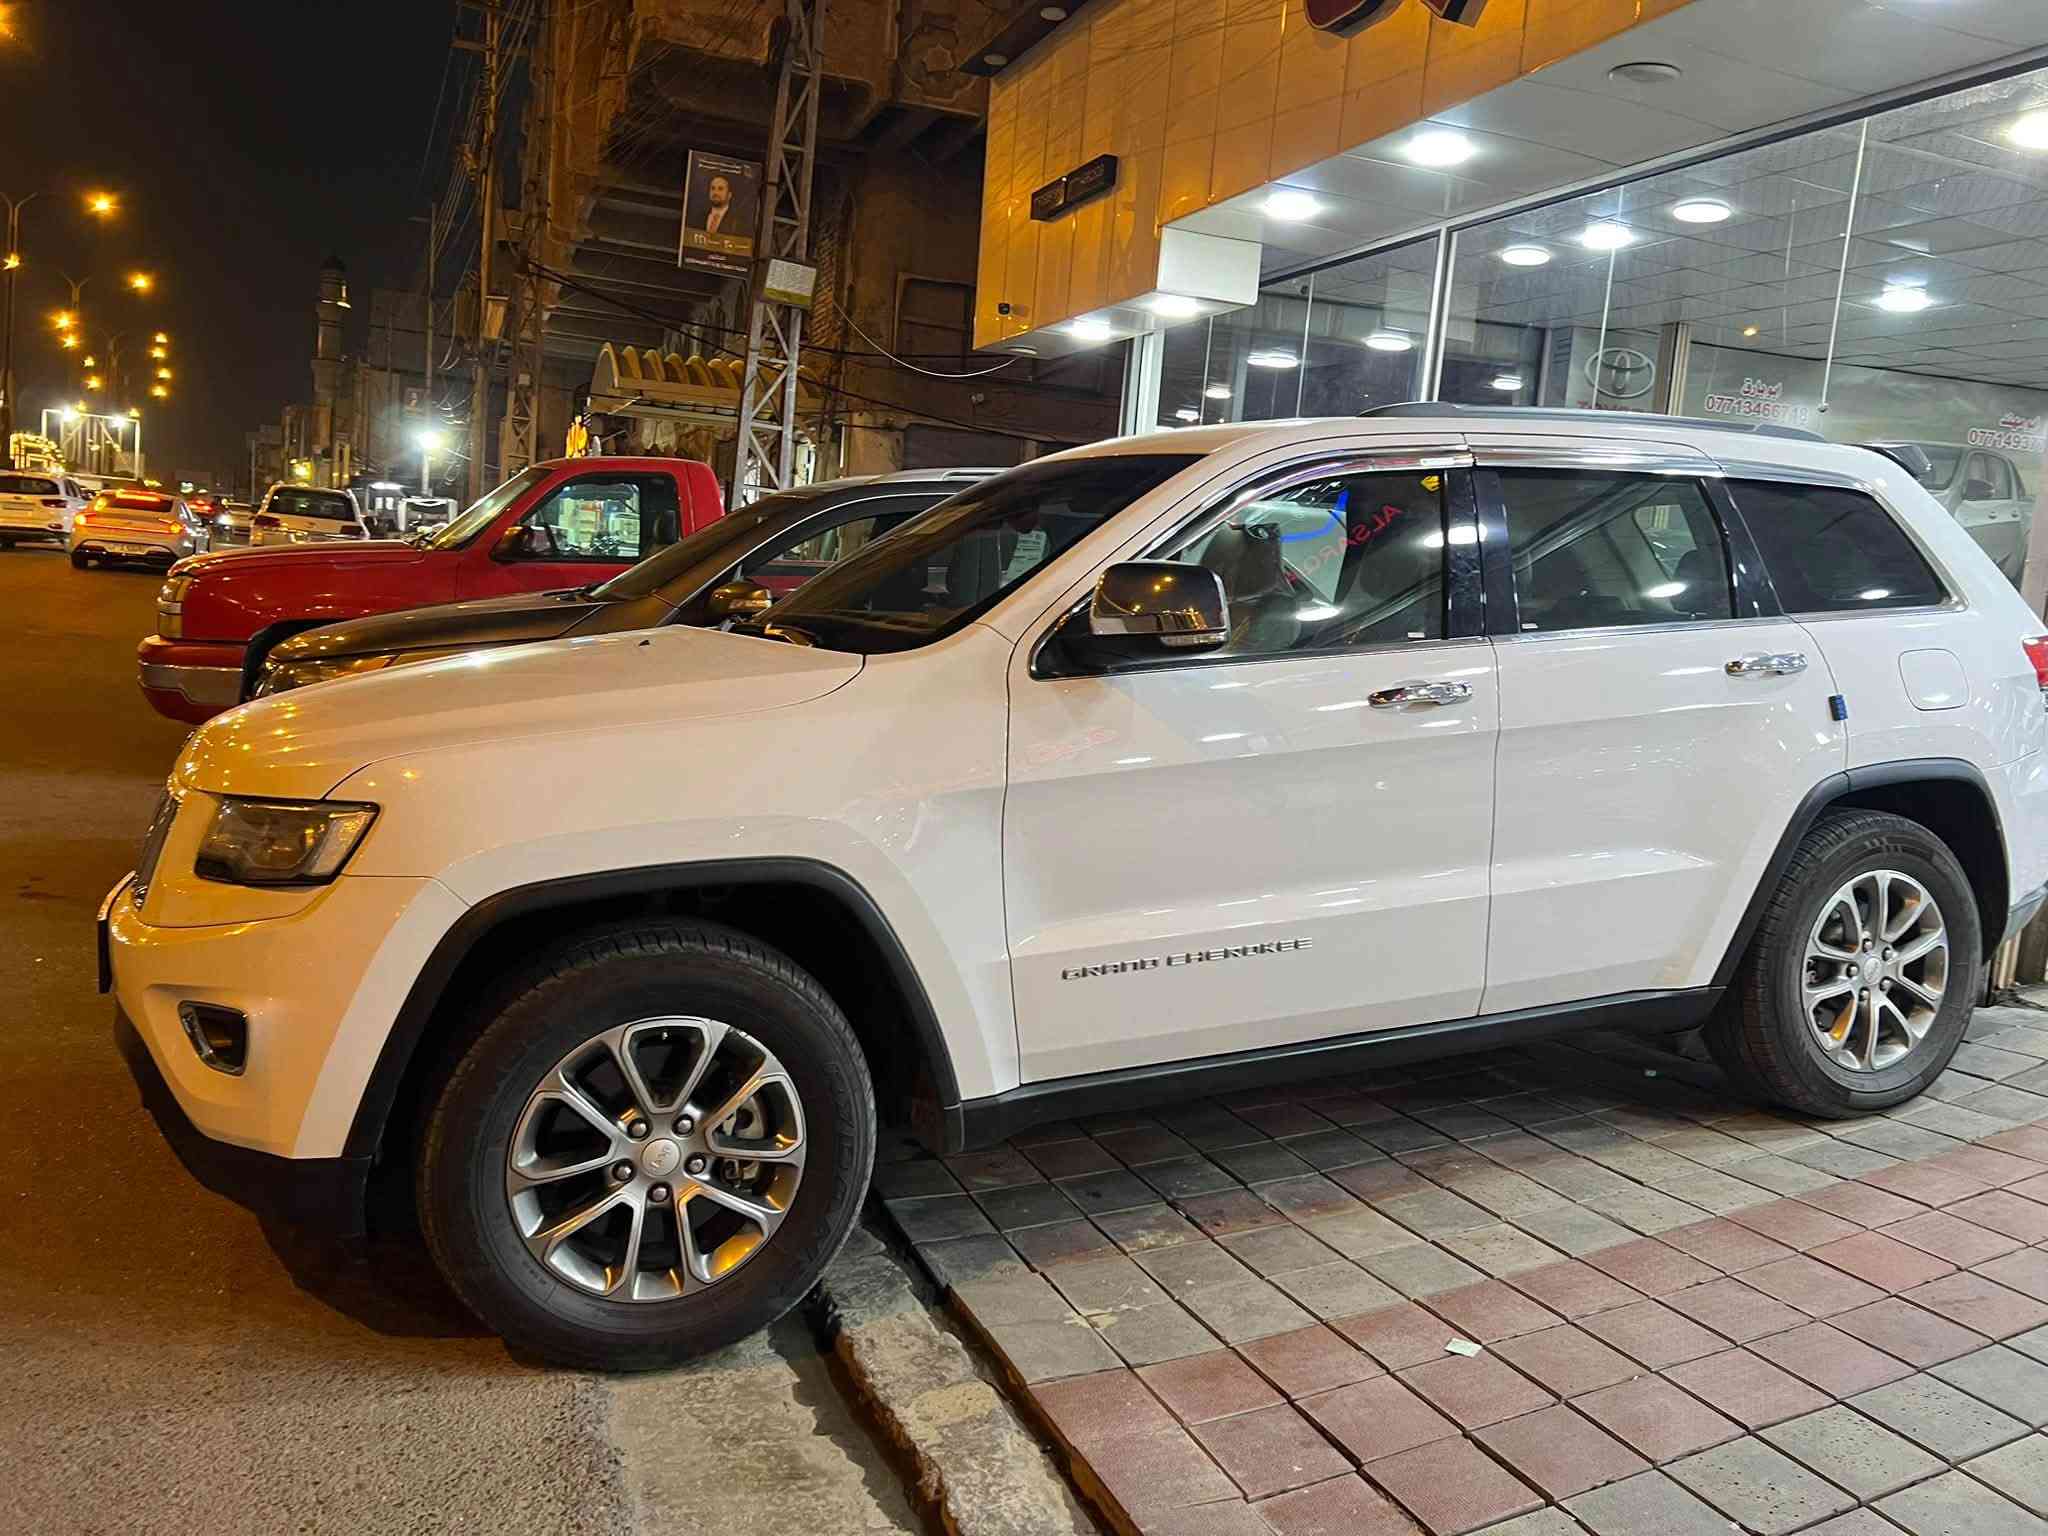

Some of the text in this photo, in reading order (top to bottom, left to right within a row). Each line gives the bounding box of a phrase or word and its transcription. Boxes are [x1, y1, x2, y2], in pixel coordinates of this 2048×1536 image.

[1704, 394, 1809, 420] 07713466718
[1062, 937, 1313, 981] GRAND CHEROKEE
